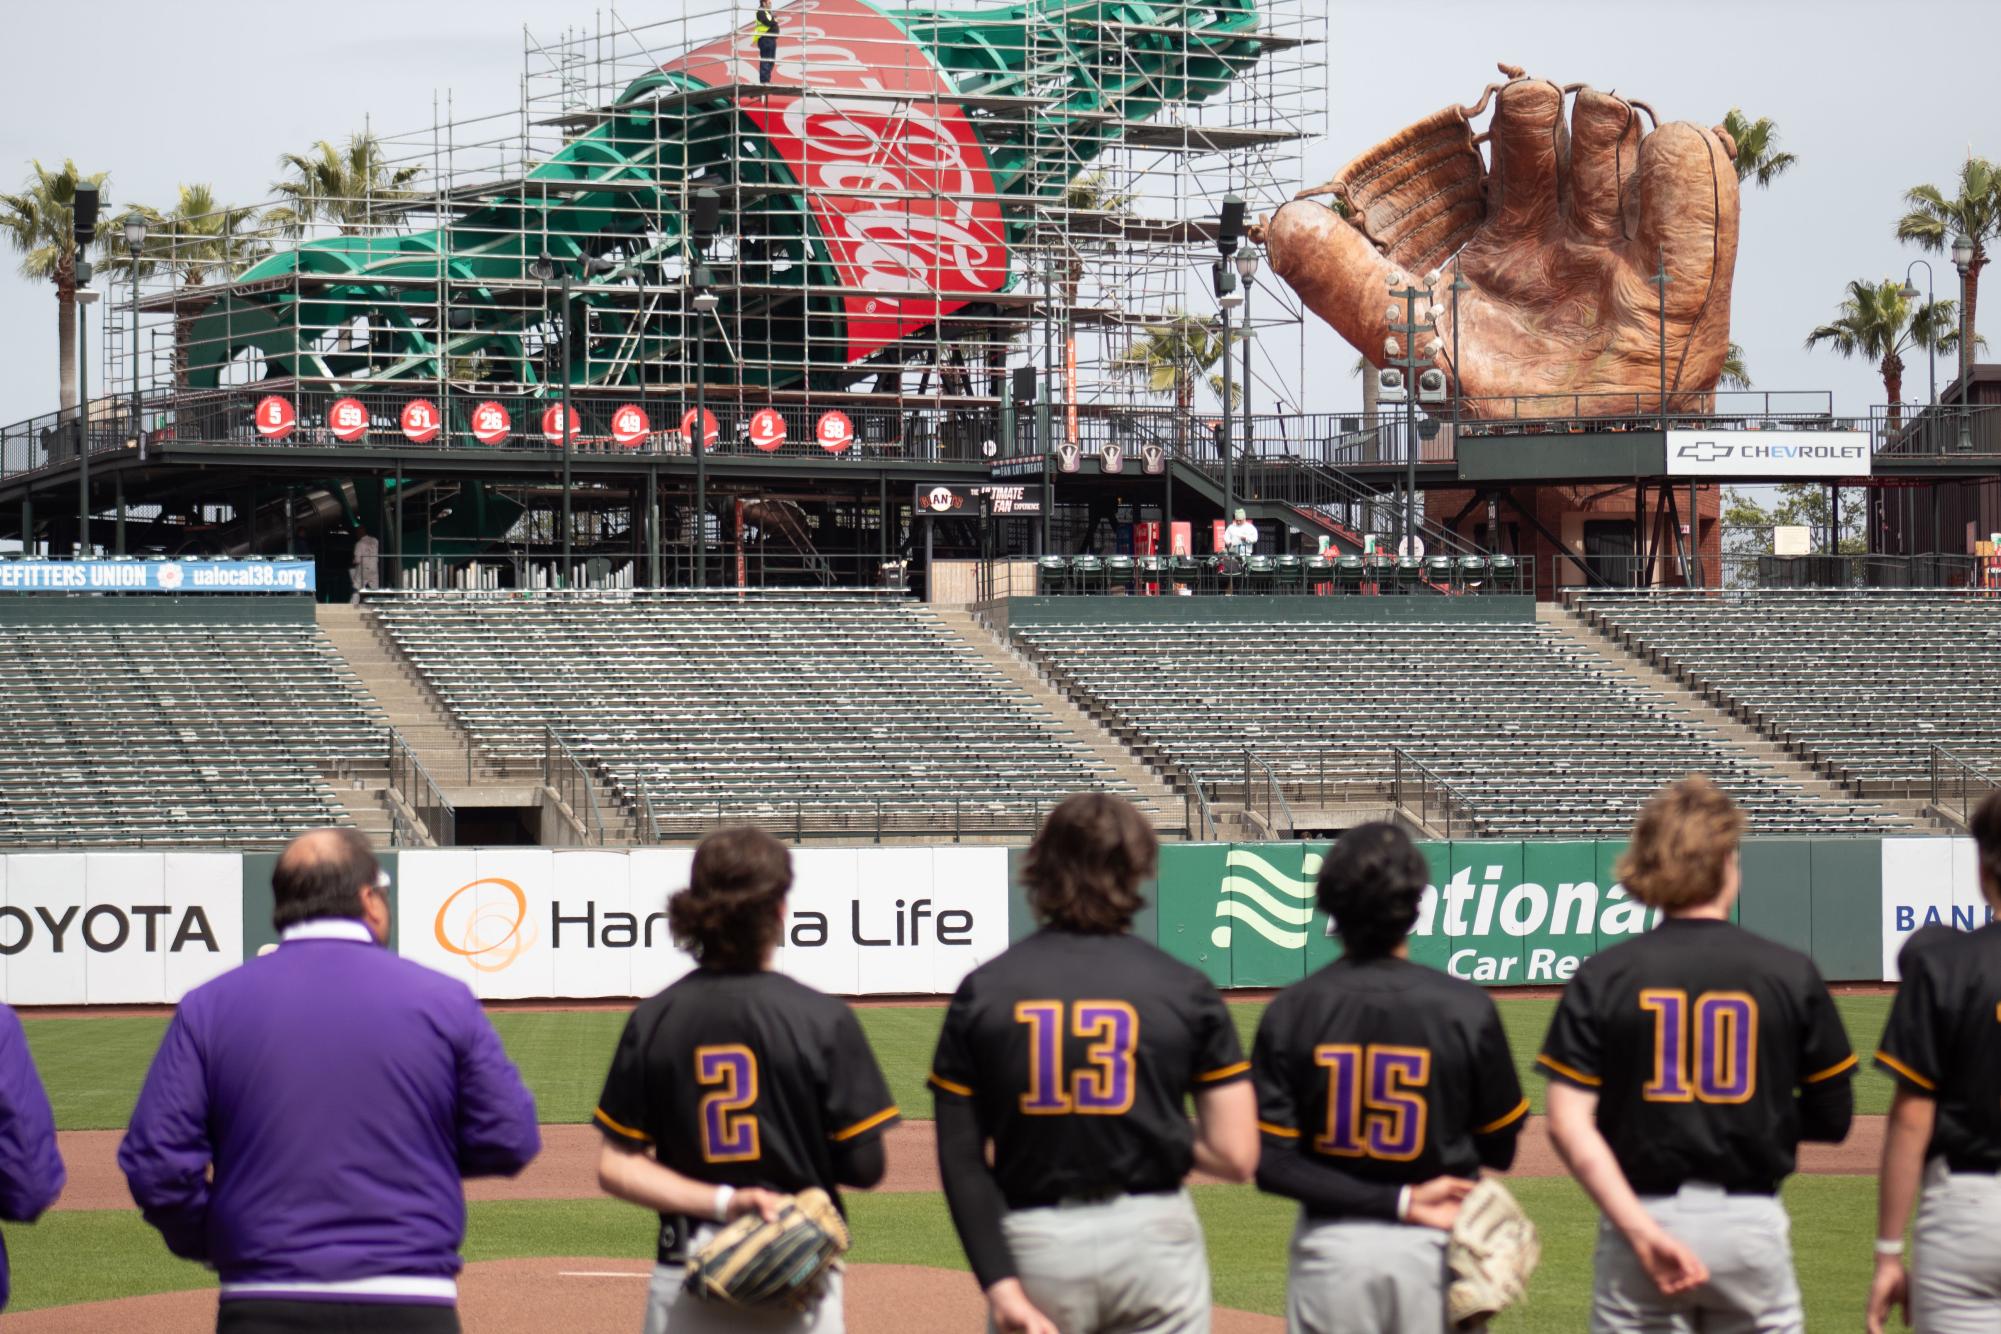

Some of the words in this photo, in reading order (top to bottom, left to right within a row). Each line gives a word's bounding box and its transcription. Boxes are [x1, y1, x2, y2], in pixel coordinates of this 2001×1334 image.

[269, 407, 281, 424] 5
[339, 408, 361, 426] 59
[411, 409, 431, 427] 31
[480, 412, 502, 429] 26
[619, 415, 640, 432] 49
[762, 420, 773, 436] 2
[824, 421, 844, 438] 58
[1741, 446, 1865, 458] CHEVROLET
[1023, 462, 1043, 475] TREATS
[993, 500, 1012, 512] FAN
[0, 565, 86, 586] EFITTERS
[91, 565, 146, 585] UNION
[194, 566, 306, 588] ualocal38.org
[1325, 865, 1664, 936] ationa
[552, 899, 828, 947] Hana
[851, 899, 974, 946] Life
[1447, 949, 1518, 981] Car
[1527, 949, 1591, 980] Re
[1639, 989, 1758, 1104] 10
[1014, 1000, 1139, 1115] 13
[695, 1044, 761, 1163] 2
[1314, 1044, 1431, 1162] 15
